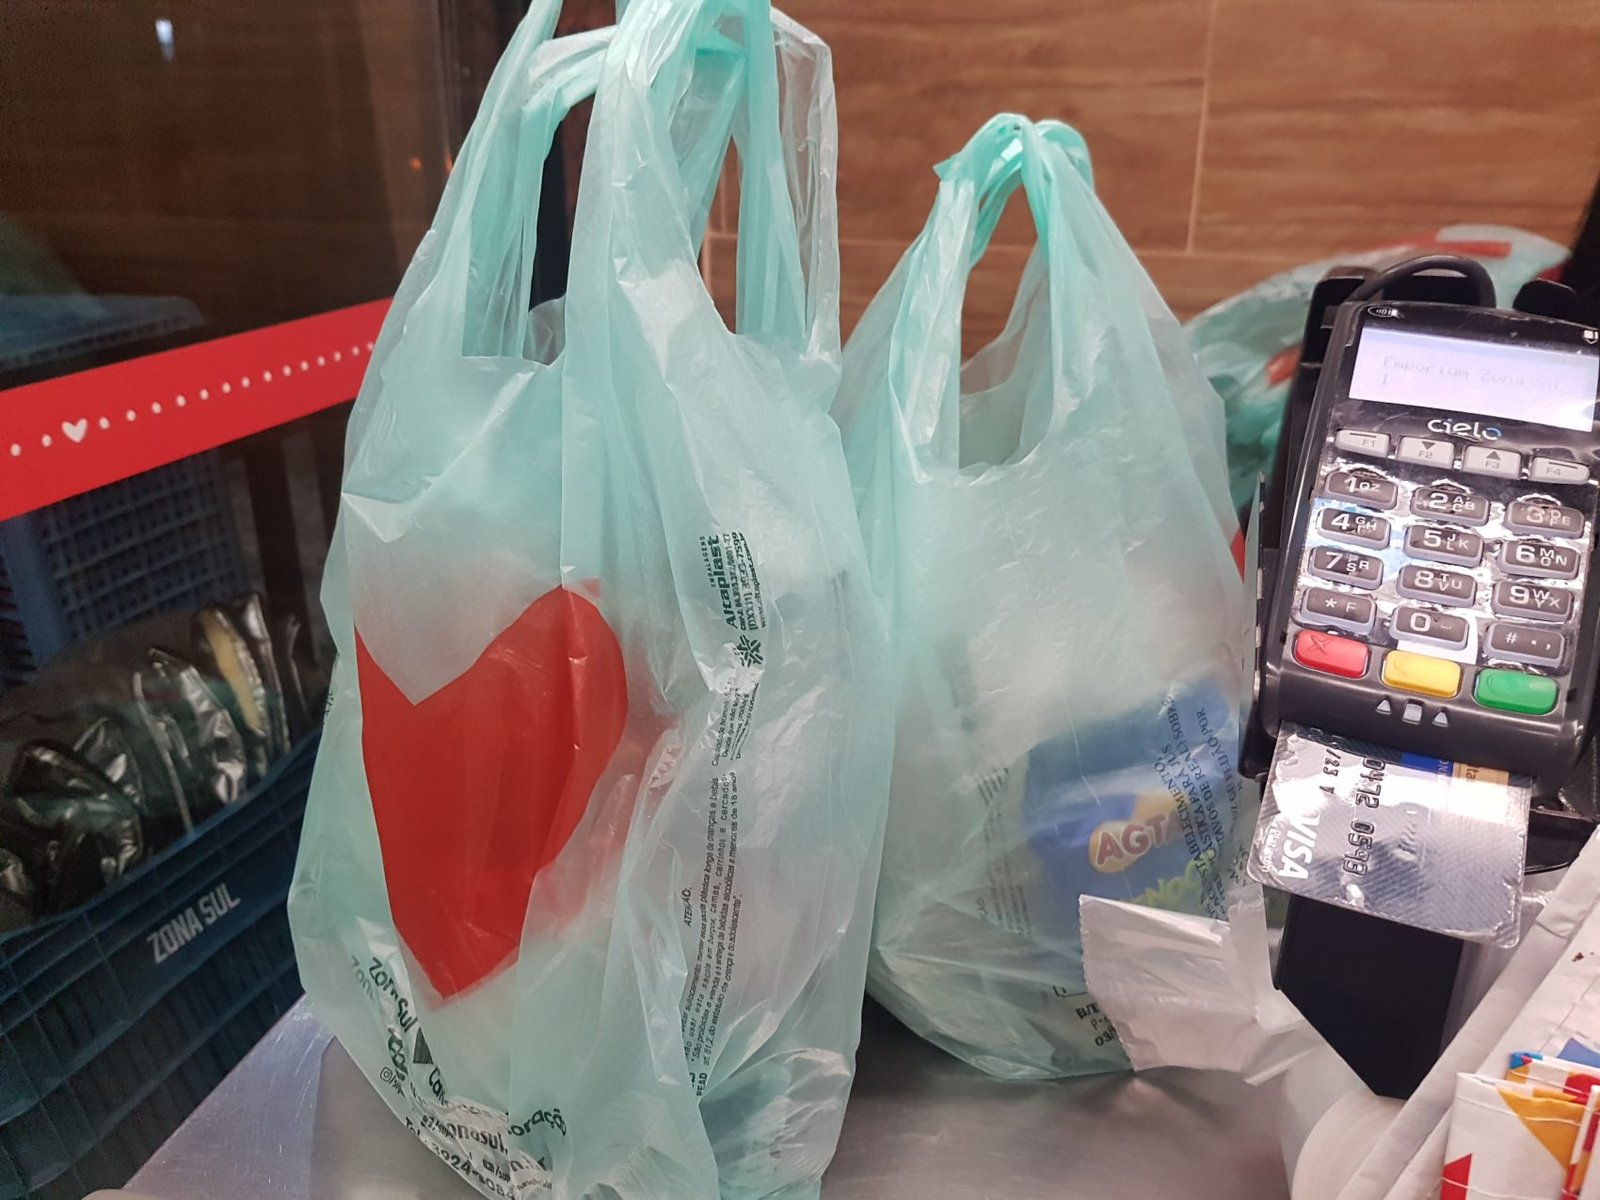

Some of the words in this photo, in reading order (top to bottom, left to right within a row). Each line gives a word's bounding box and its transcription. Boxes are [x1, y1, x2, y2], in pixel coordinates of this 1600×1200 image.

[1427, 417, 1503, 442] cielo
[1362, 439, 1377, 449] F1
[1418, 450, 1434, 461] F2
[1484, 459, 1501, 471] F3
[1545, 466, 1562, 477] F4
[1344, 477, 1357, 493] 1
[1429, 492, 1449, 511] 2
[1526, 506, 1546, 525] 3
[1330, 512, 1351, 531] 4
[1422, 529, 1442, 548] 5
[1515, 545, 1536, 564] 6
[1324, 551, 1341, 571] 7
[1413, 569, 1435, 589] 8
[1508, 585, 1531, 606] 9
[1409, 614, 1431, 633] 0
[1355, 756, 1386, 809] 0472
[1277, 814, 1321, 880] VISA
[1341, 819, 1376, 876] 0593
[146, 906, 205, 965] ZONA
[198, 882, 242, 926] SUL
